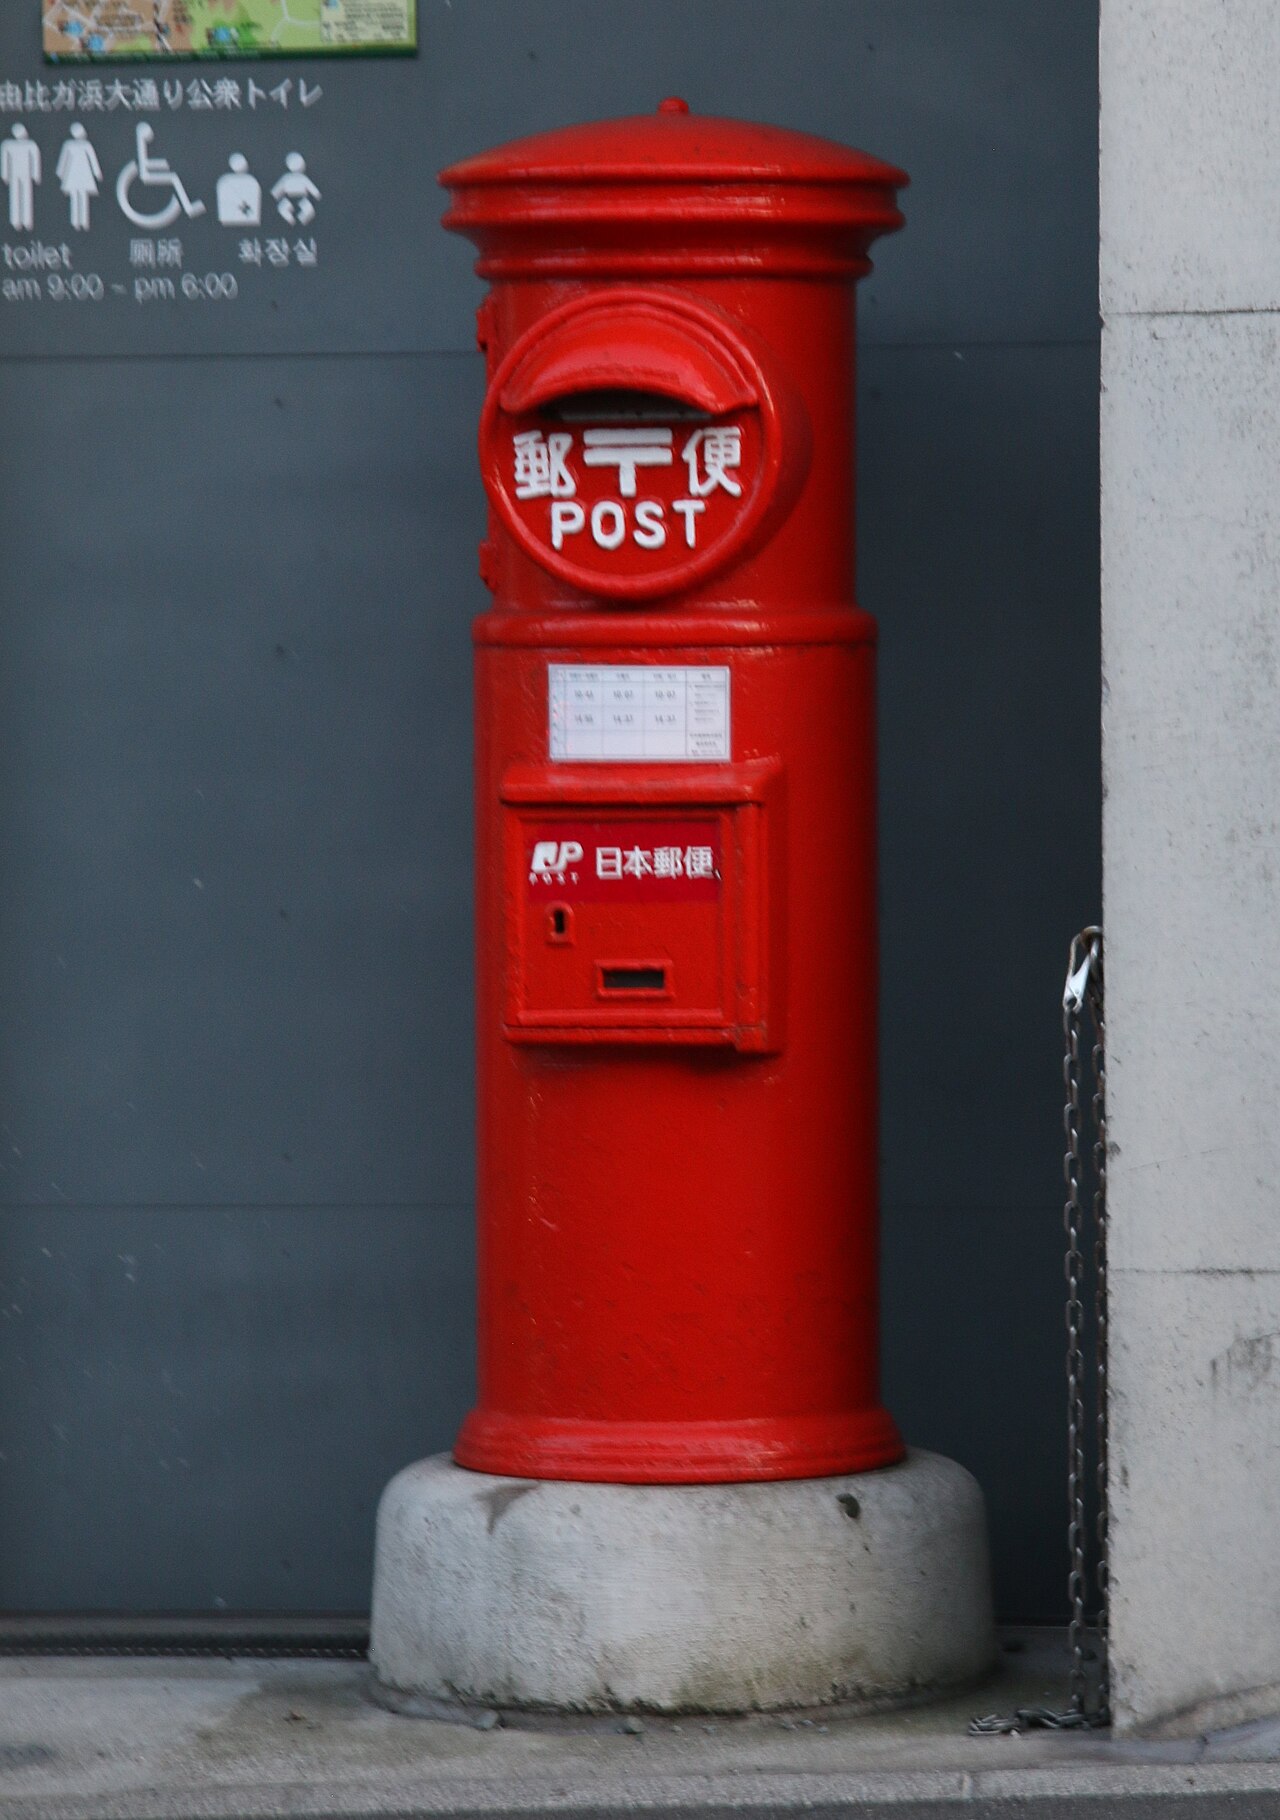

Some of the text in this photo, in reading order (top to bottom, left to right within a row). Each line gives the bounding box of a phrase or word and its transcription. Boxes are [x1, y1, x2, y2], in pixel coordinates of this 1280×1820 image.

[1, 240, 73, 270] toilet
[238, 236, 319, 268] 화장실
[1, 278, 42, 301] am
[47, 273, 105, 301] 9:00
[134, 277, 176, 305] pm
[181, 272, 239, 301] 6:00
[550, 499, 707, 550] POST
[594, 844, 715, 880] 日本郵便
